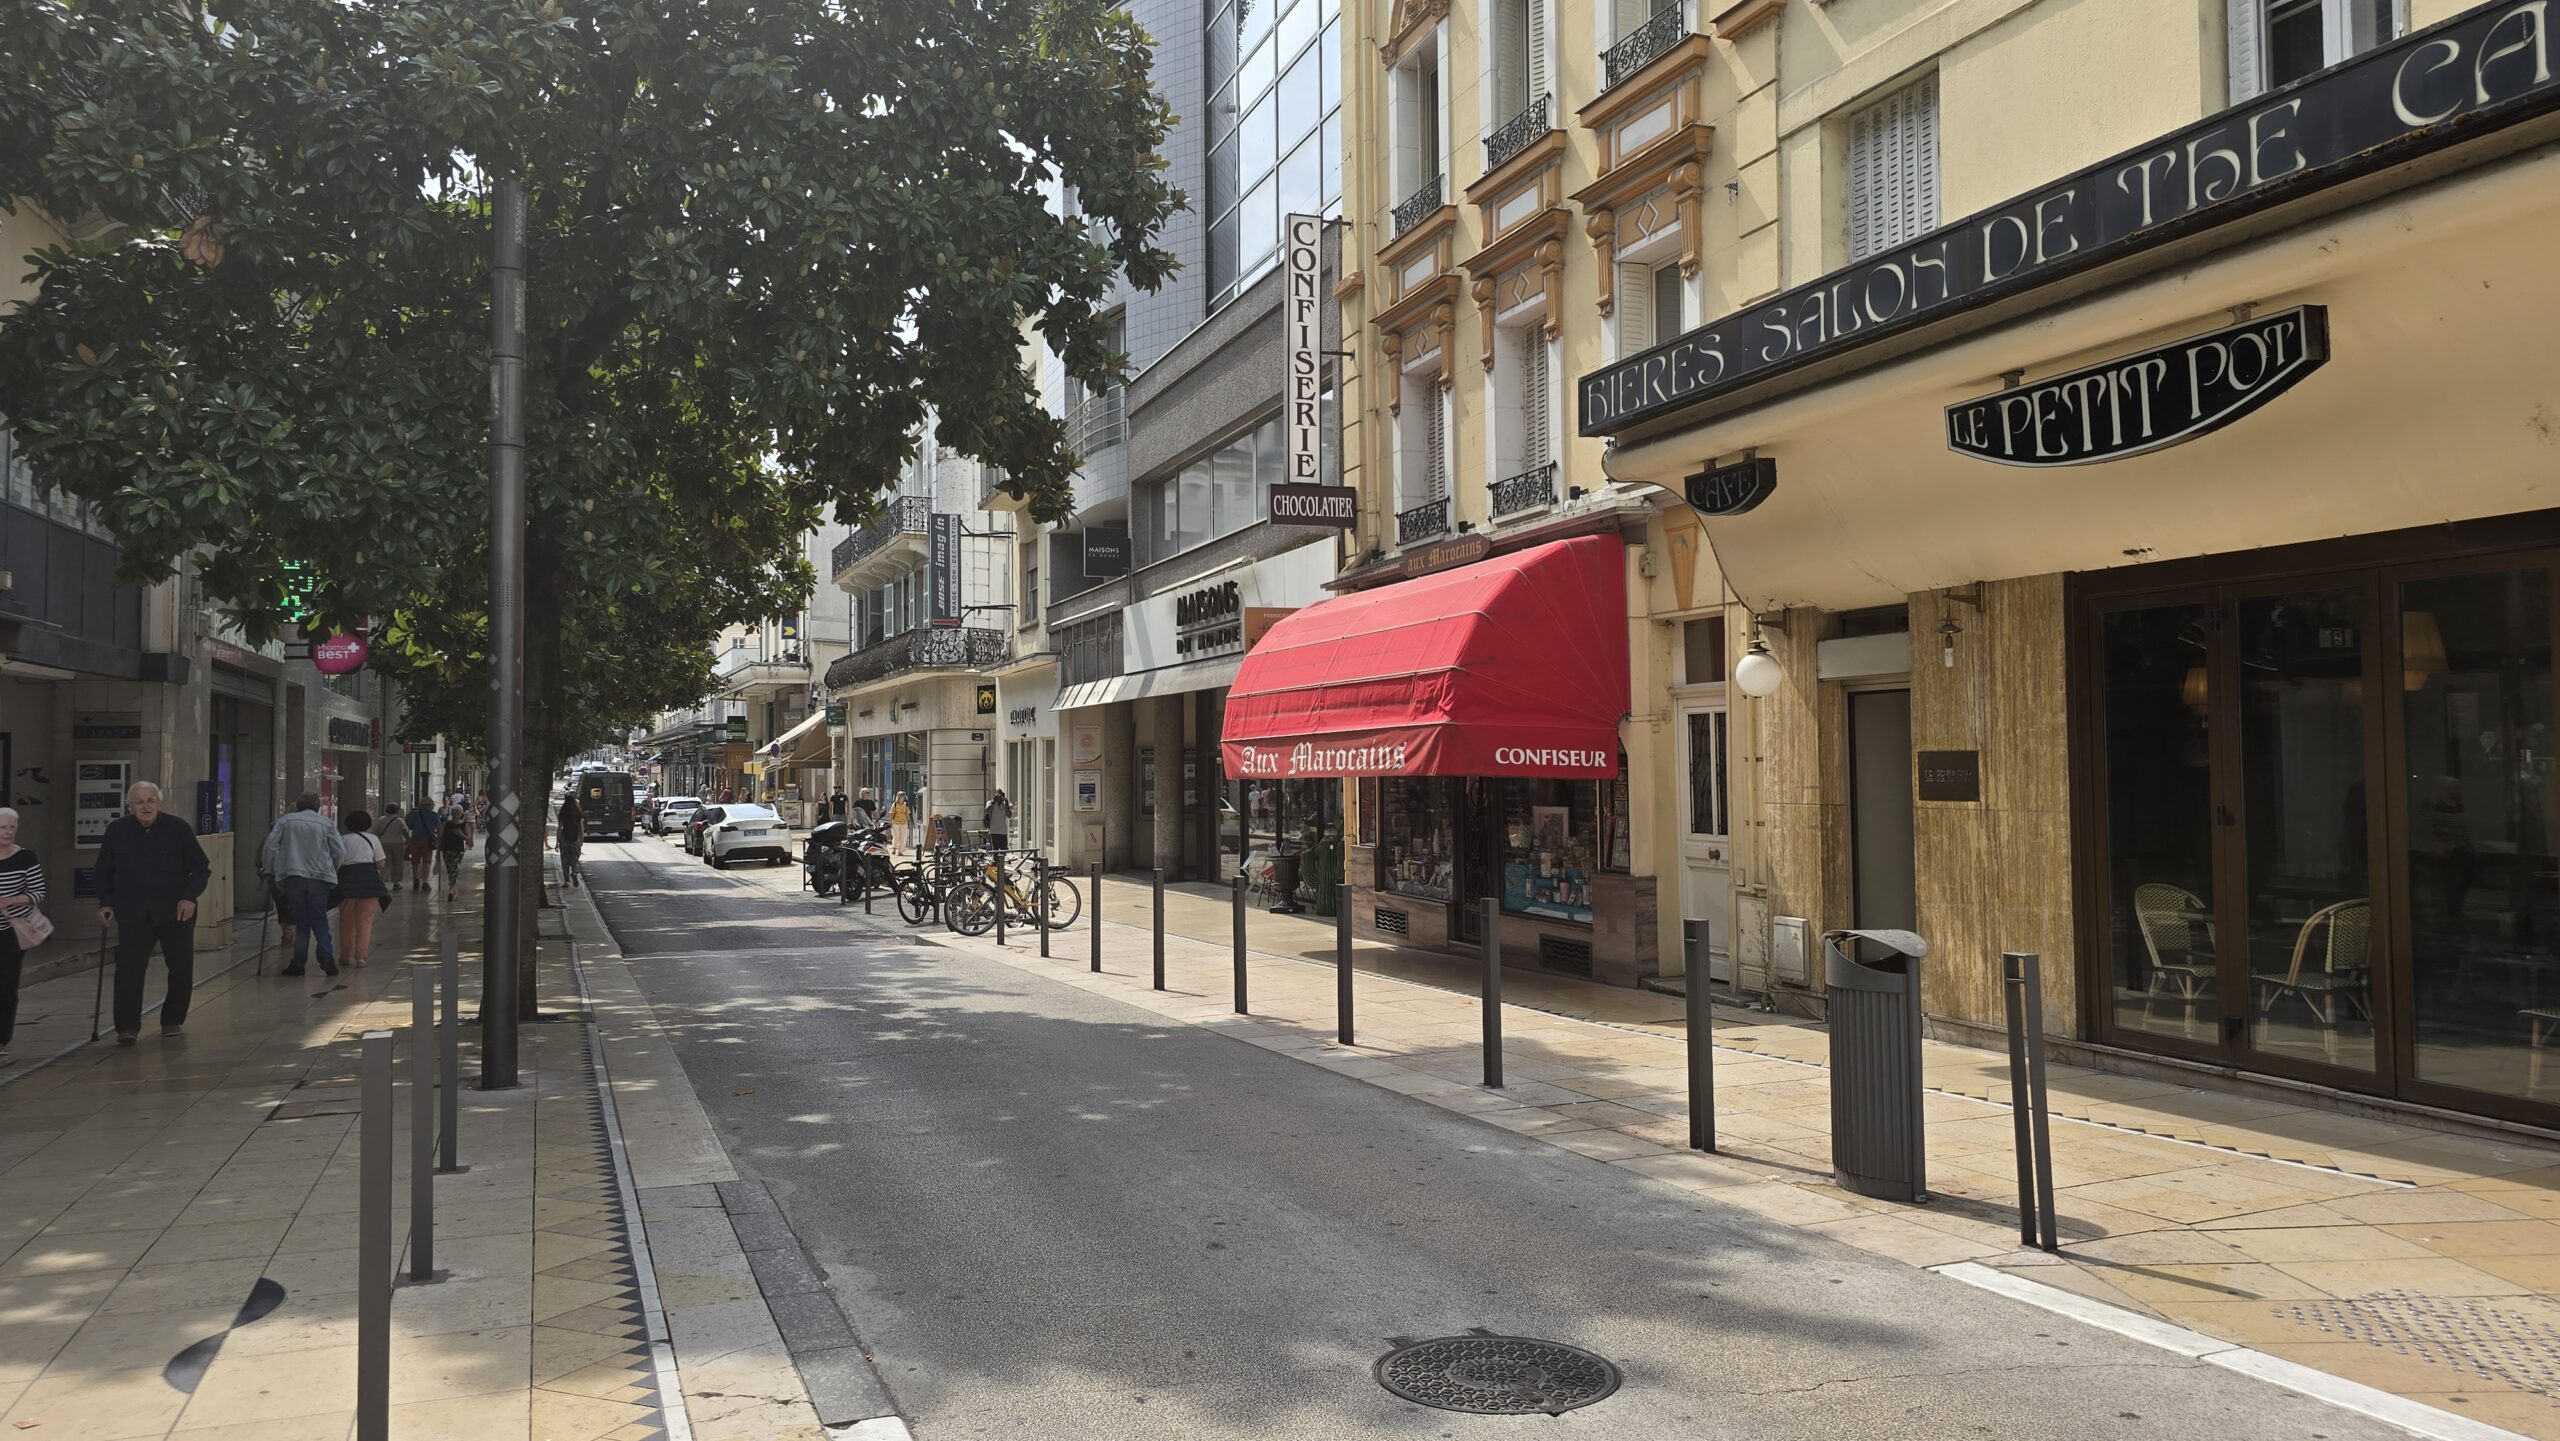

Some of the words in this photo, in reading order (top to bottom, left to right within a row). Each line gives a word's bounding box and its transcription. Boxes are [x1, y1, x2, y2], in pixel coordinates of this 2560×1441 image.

[1587, 334, 1725, 427] BIERES
[1761, 241, 1949, 363] SALON
[1982, 190, 2079, 285] DE
[2117, 99, 2306, 227] THE
[1291, 221, 1317, 479] CONFISERIE
[1953, 406, 1988, 449] LE
[1999, 357, 2168, 458] PETIT
[2186, 320, 2295, 420] POT
[1273, 495, 1354, 518] CHOCOLATIER
[1692, 470, 1752, 511] CAFE
[1088, 546, 1120, 554] MAISONS
[1408, 556, 1424, 572] aux
[1429, 541, 1482, 567] Marocains
[1177, 580, 1240, 627] MAISONS
[1240, 745, 1279, 774] Aux
[1288, 739, 1407, 776] Marocains
[1495, 747, 1607, 768] CONFISEUR
